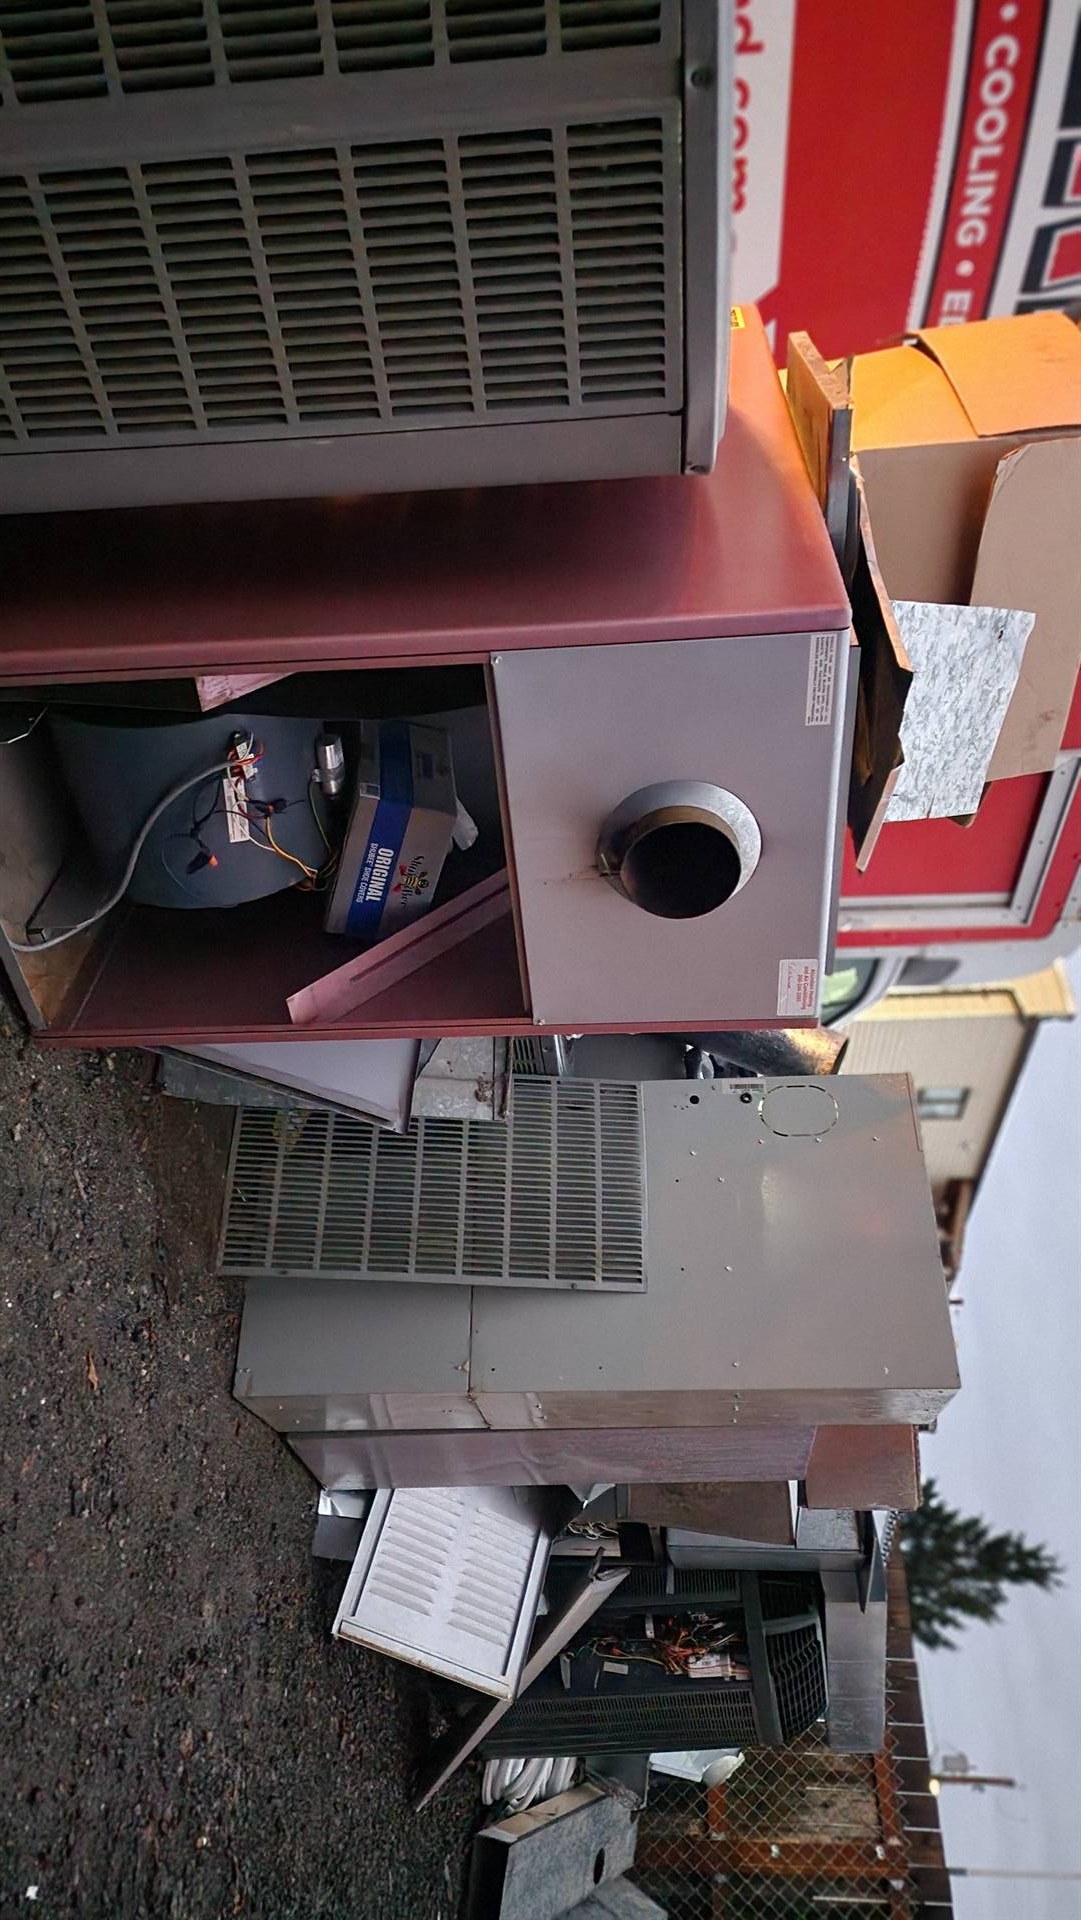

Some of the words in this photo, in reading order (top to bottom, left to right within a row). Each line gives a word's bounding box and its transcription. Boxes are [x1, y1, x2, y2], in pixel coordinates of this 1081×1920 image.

[957, 35, 1019, 247] COOLING
[356, 882, 368, 903] COVERS
[361, 867, 372, 882] SHOE
[365, 848, 394, 901] ORIGINAL
